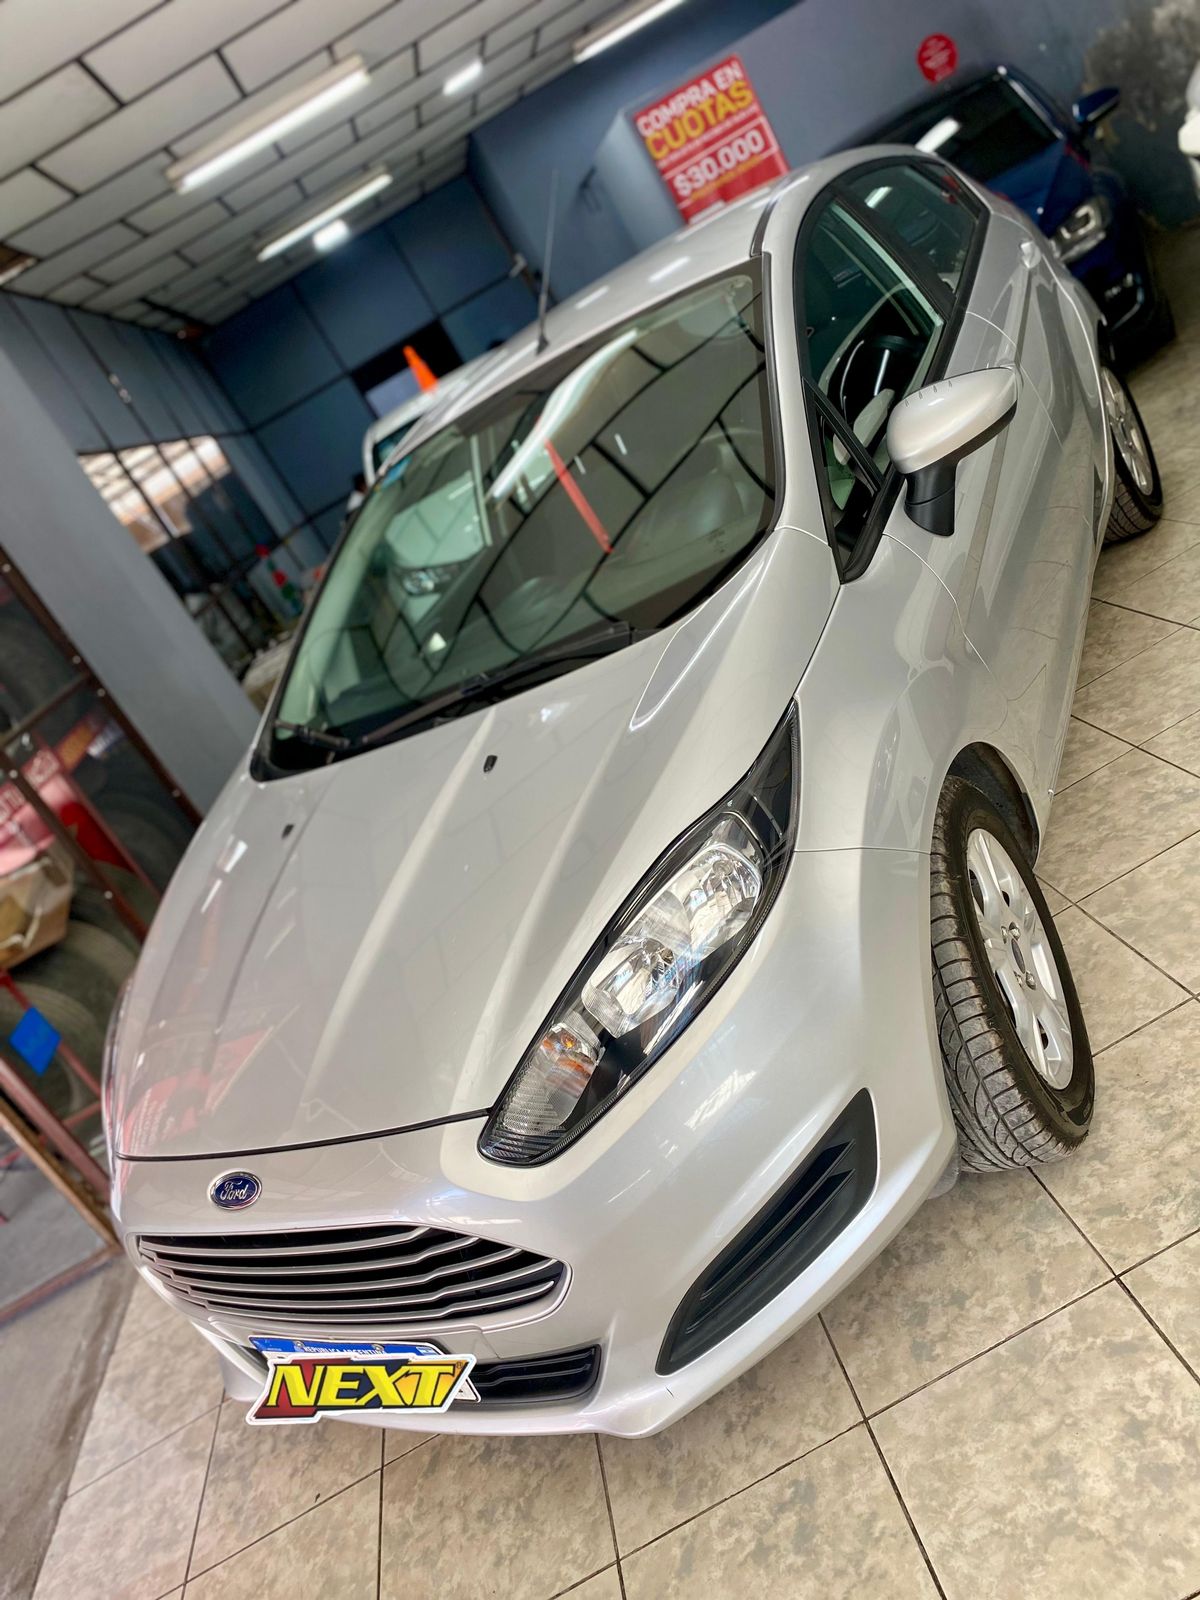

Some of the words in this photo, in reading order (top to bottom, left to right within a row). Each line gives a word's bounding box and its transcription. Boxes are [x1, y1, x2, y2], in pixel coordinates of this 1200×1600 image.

[636, 78, 717, 137] COMPRA
[712, 60, 744, 91] EN
[645, 80, 754, 160] CUOTAS
[673, 129, 765, 197] $30.000
[220, 1180, 249, 1201] Ford
[266, 1364, 455, 1407] NEXT
